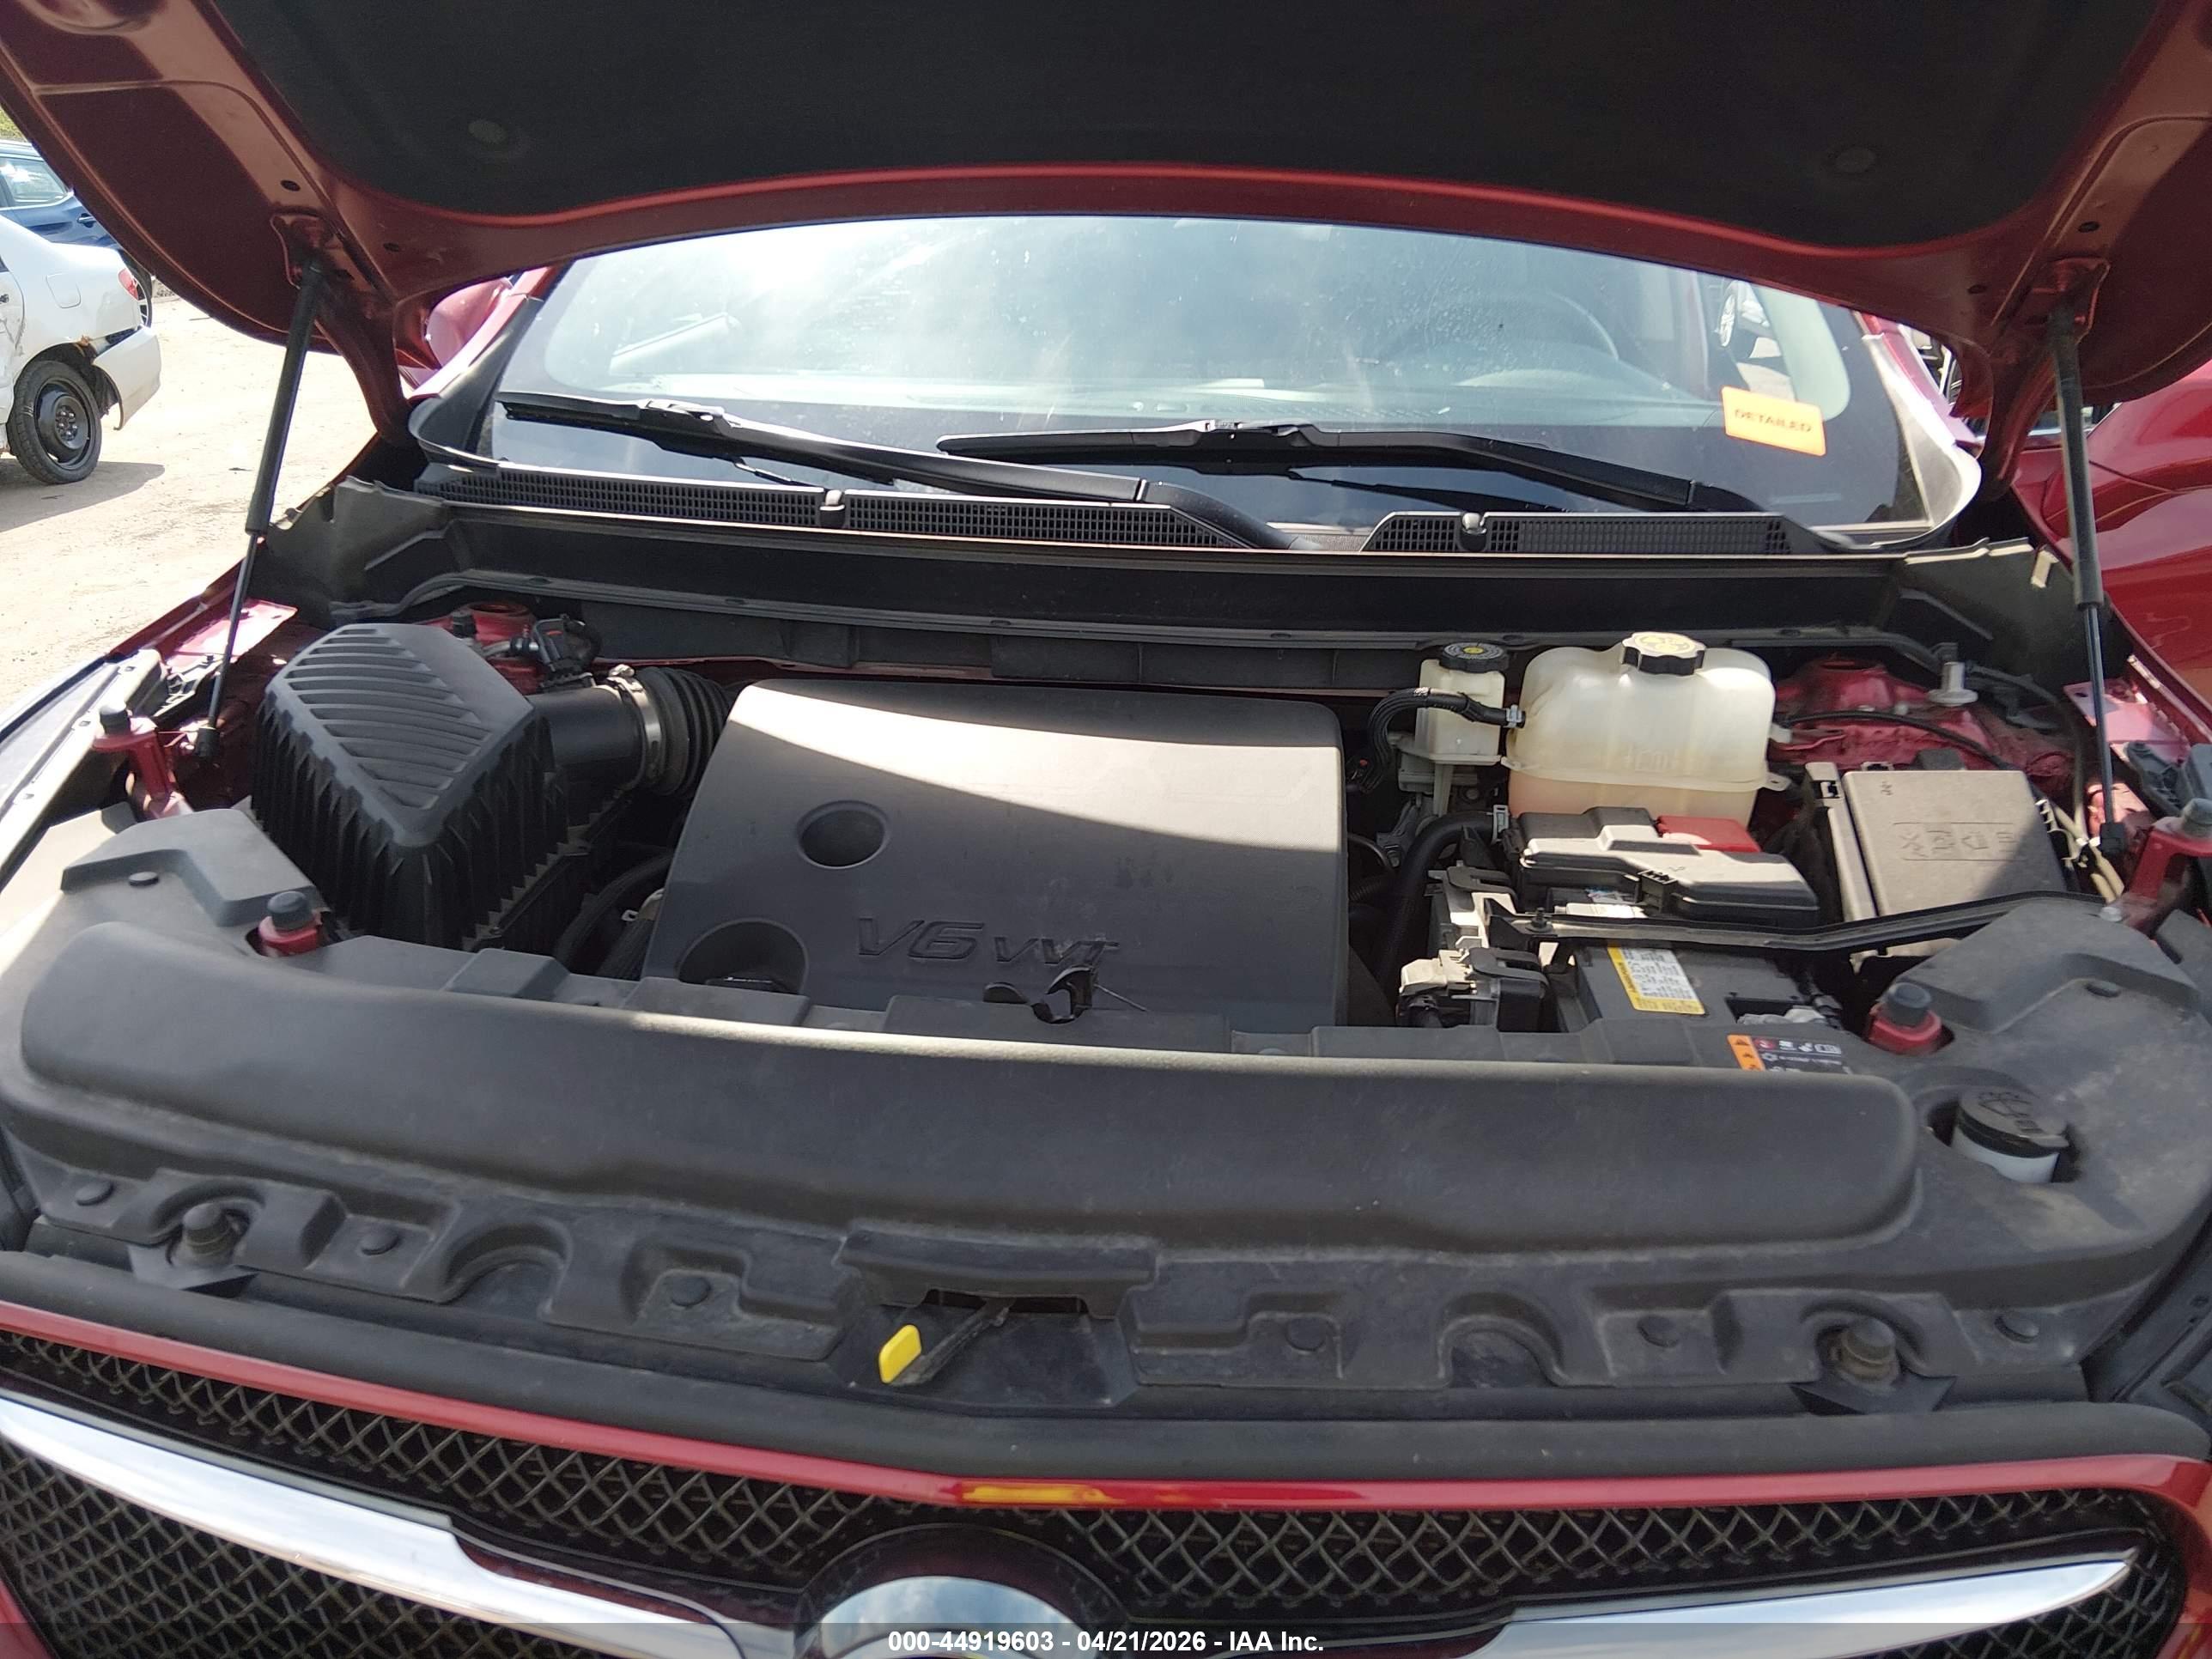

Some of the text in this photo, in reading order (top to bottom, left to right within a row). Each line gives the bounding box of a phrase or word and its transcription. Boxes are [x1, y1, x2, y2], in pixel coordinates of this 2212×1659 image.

[1734, 408, 1812, 433] DETAILED
[859, 917, 1120, 969] V6 VVT
